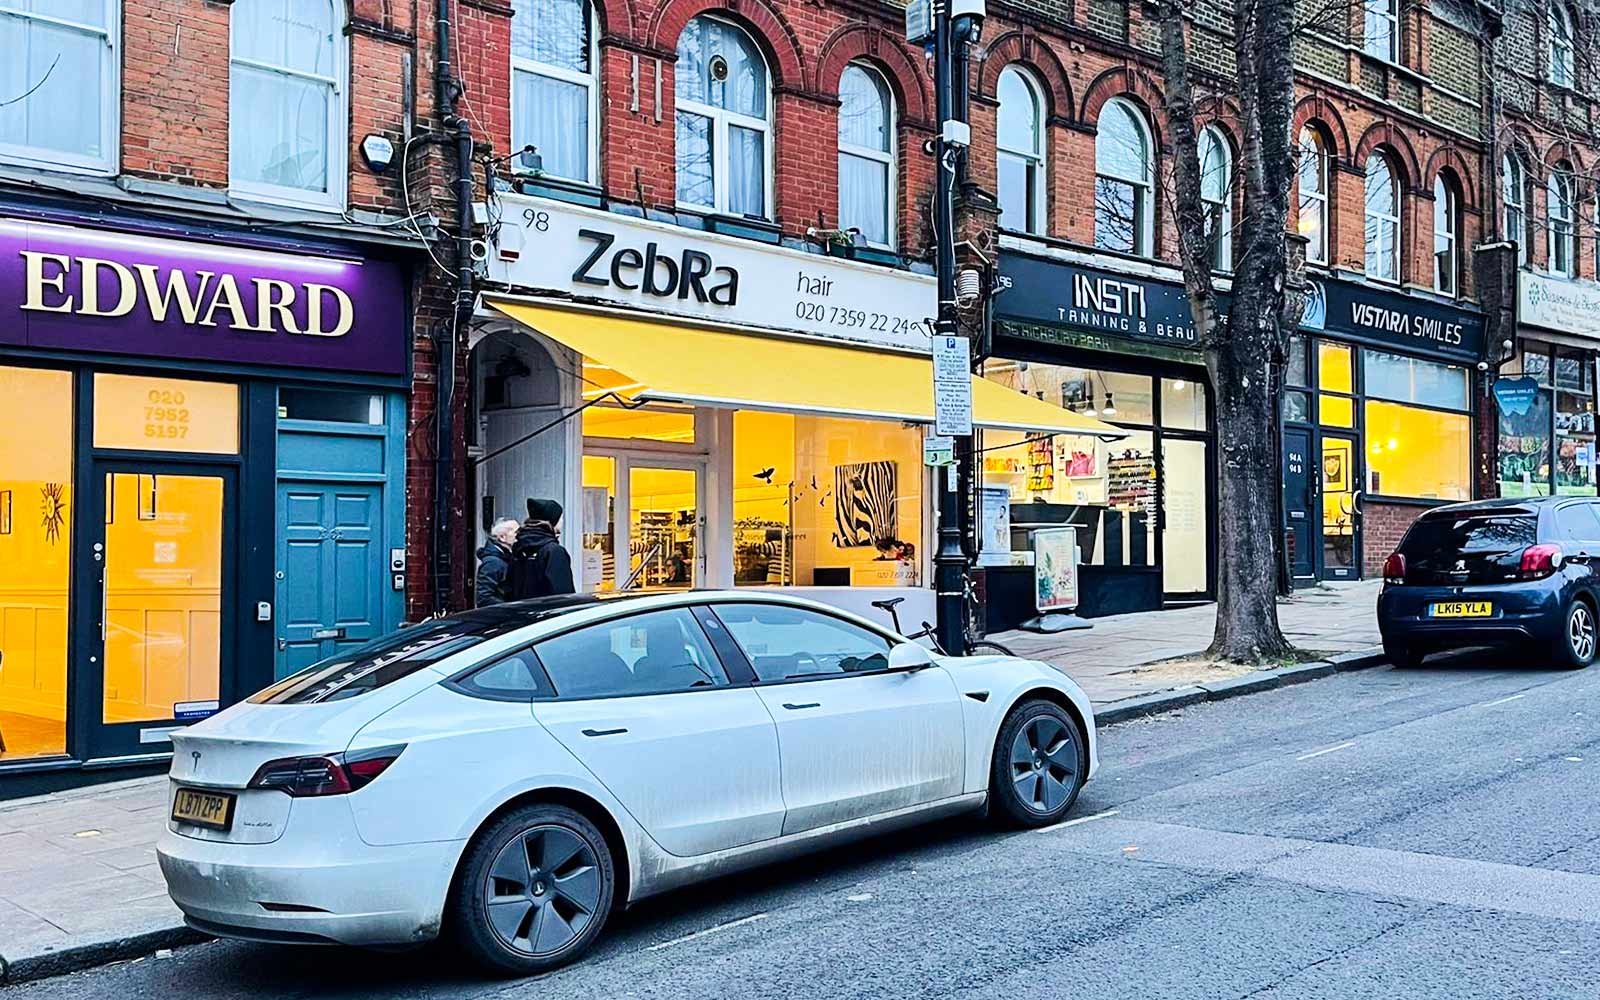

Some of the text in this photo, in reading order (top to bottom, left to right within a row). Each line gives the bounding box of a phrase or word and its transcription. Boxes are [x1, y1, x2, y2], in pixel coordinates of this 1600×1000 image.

[523, 208, 550, 232] 98
[572, 228, 739, 306] ZebRa
[19, 250, 354, 337] EDWARD
[797, 271, 834, 297] hair
[1073, 273, 1147, 318] INSTI
[796, 301, 825, 322] 020
[830, 306, 866, 328] 7359
[1058, 308, 1129, 331] TANNING
[1138, 321, 1147, 333] &
[1351, 302, 1463, 345] VISTARA SMILES
[947, 338, 955, 348] P
[148, 390, 185, 405] 020
[144, 407, 190, 423] 7952
[144, 424, 189, 439] 5197
[1465, 603, 1487, 613] YLA
